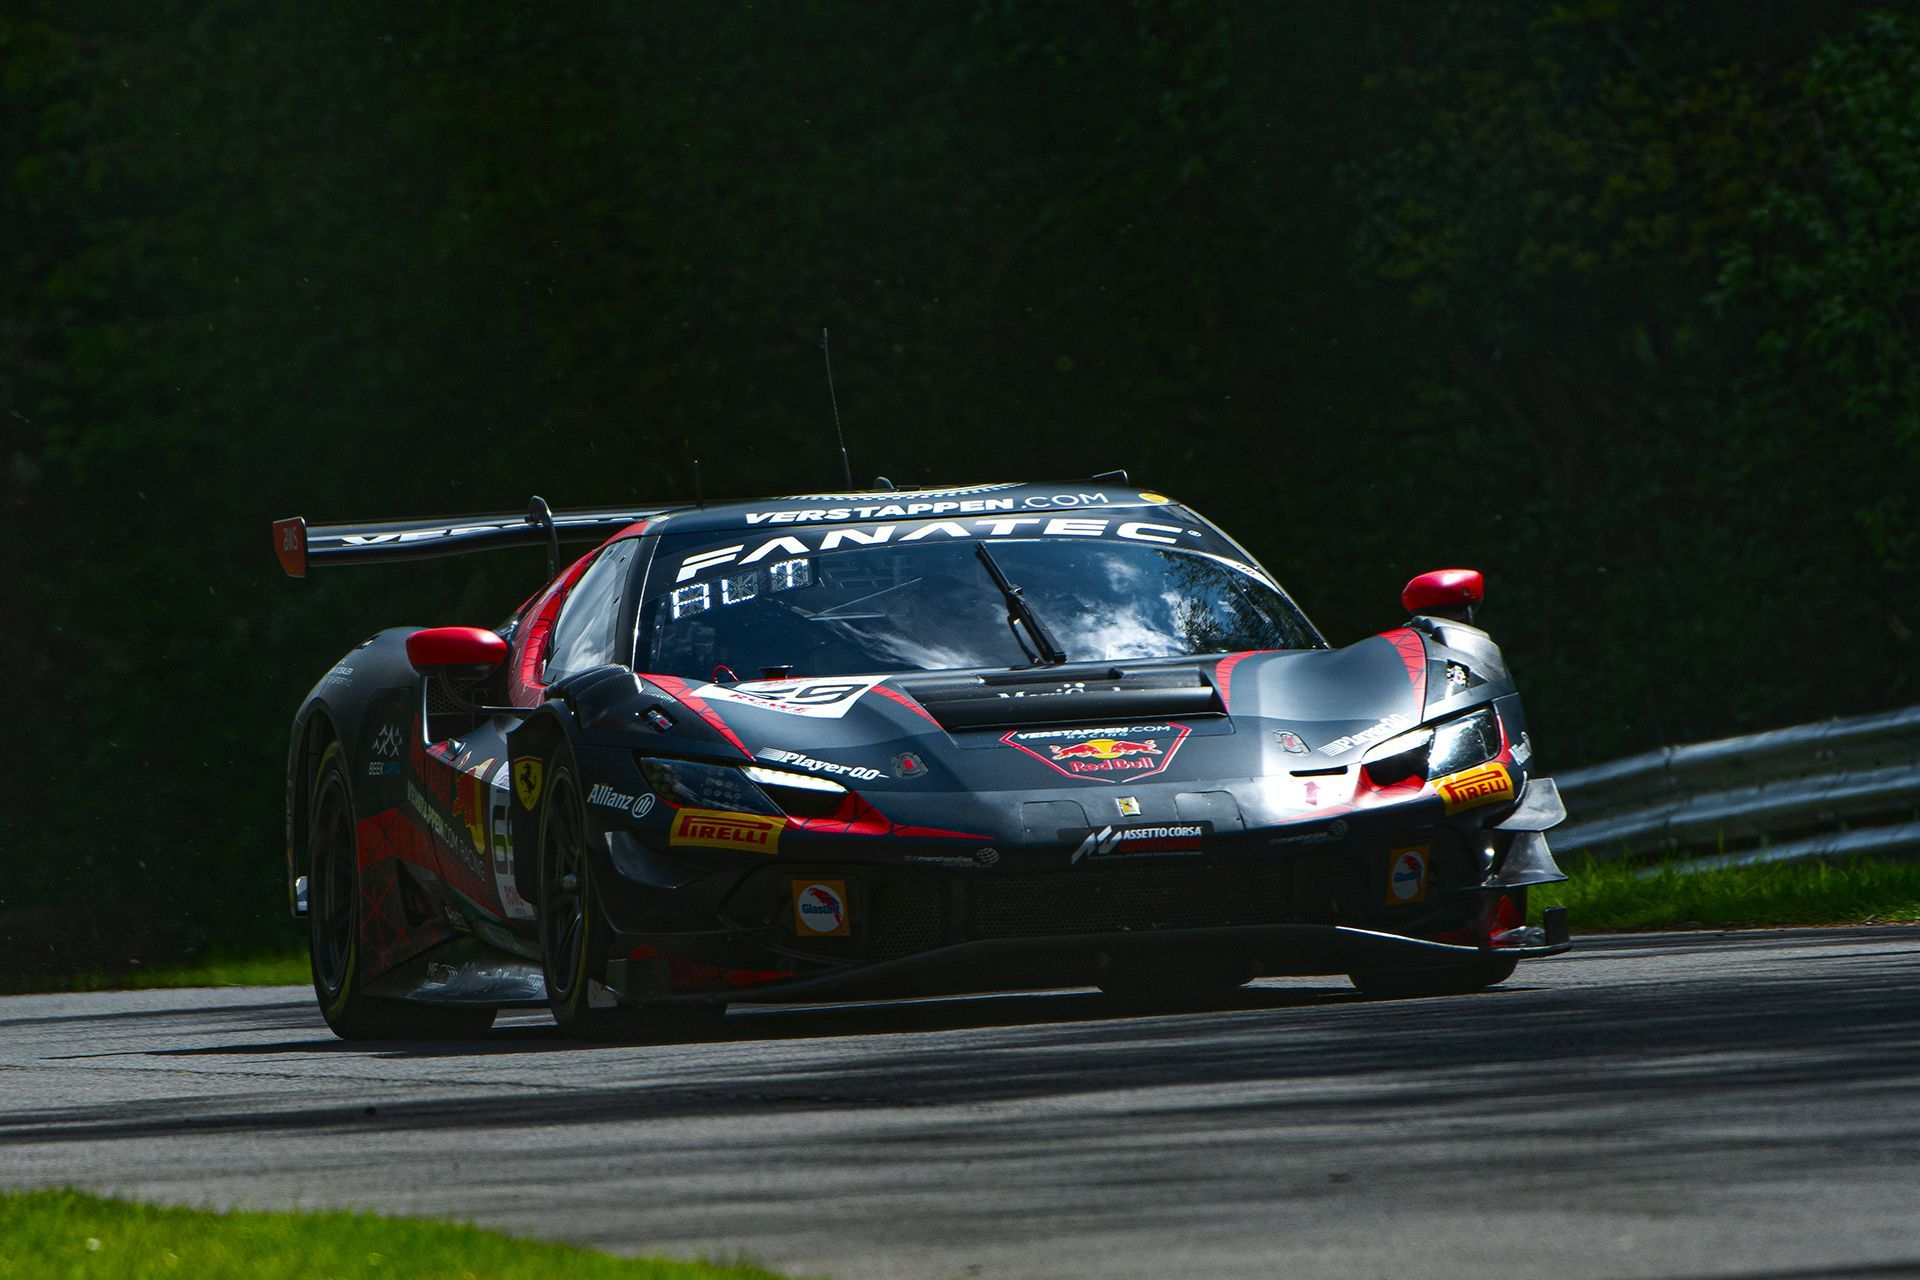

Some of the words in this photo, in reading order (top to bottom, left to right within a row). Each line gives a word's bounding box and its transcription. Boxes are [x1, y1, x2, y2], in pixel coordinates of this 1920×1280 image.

[746, 492, 1109, 525] VERSTAPPEN.COM
[676, 518, 1184, 583] FANATEC
[1016, 725, 1171, 741] VERSTAPPEN.COM
[1070, 760, 1112, 775] Red
[1113, 756, 1155, 773] Bull
[587, 783, 636, 811] Allianz
[1443, 769, 1509, 805] PIRELLI
[678, 814, 774, 845] PIRELLI
[1122, 827, 1167, 841] ASSETTO
[1168, 825, 1202, 839] CORSA
